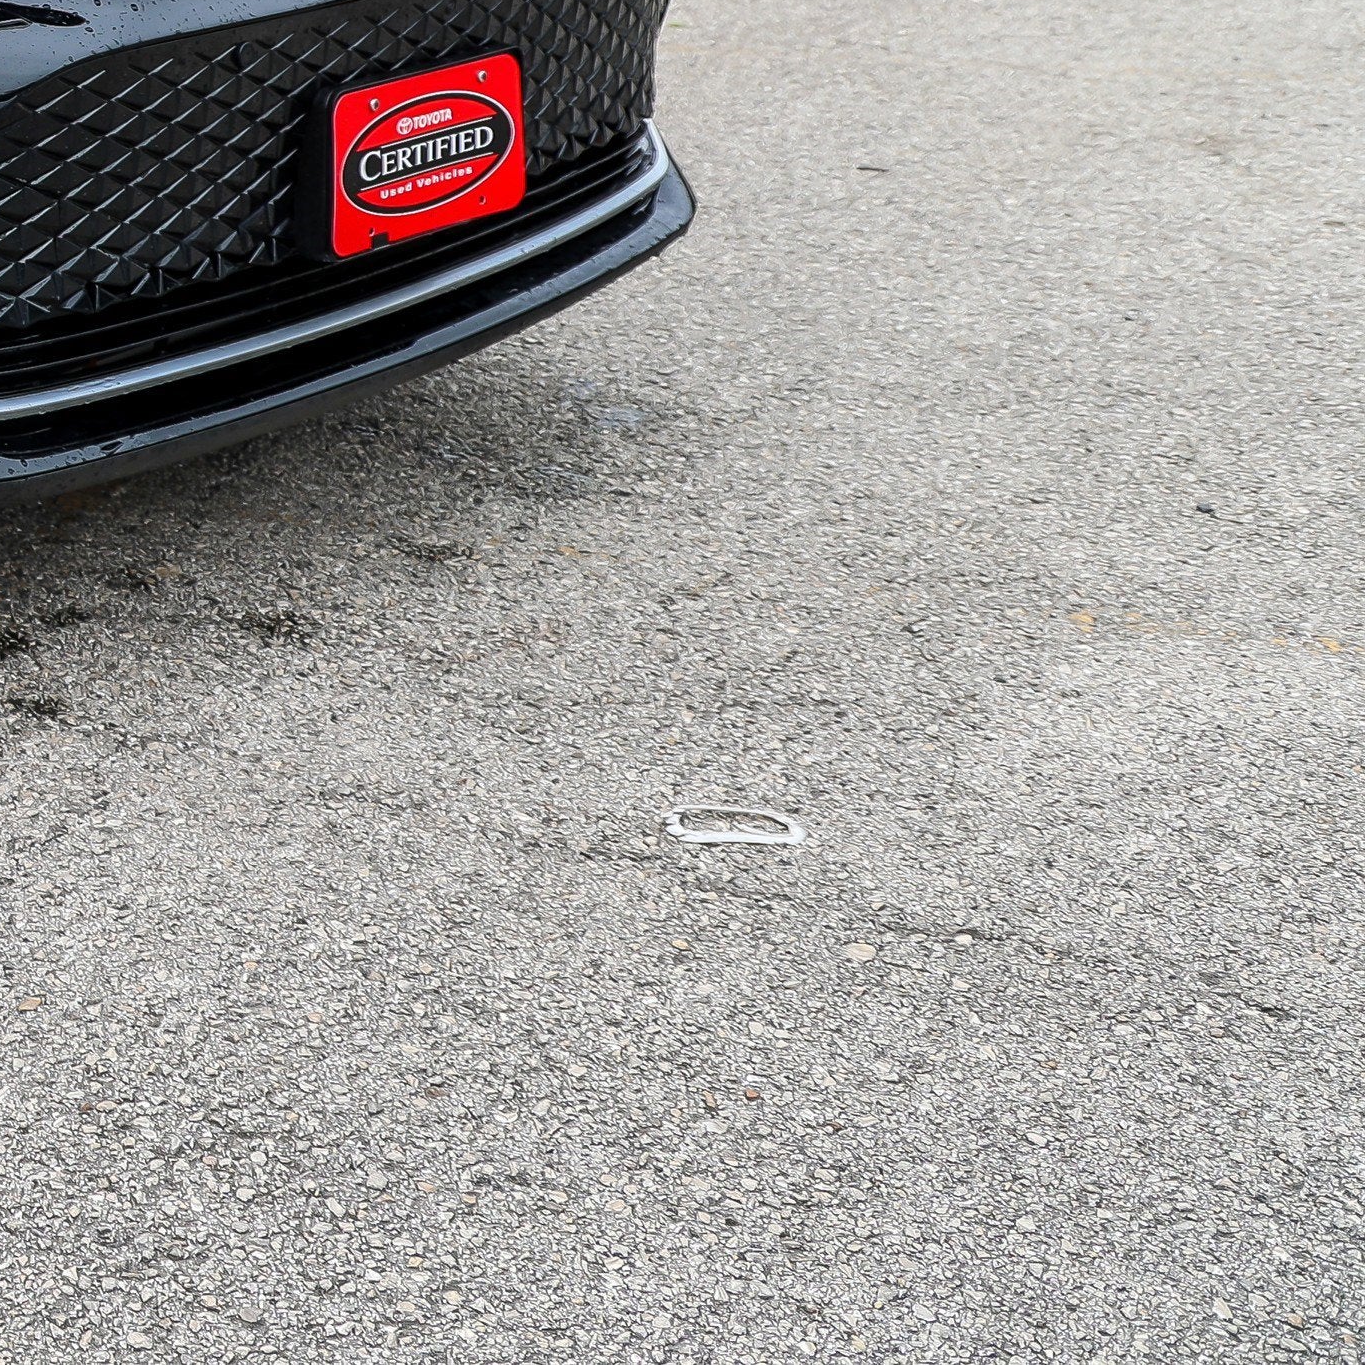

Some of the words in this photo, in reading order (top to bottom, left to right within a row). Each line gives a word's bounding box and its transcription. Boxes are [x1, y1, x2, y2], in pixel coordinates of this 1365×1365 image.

[412, 108, 453, 130] TOYOTA
[359, 126, 494, 182] CERTIFIED
[379, 182, 412, 199] Used
[416, 166, 473, 189] Vehicles
